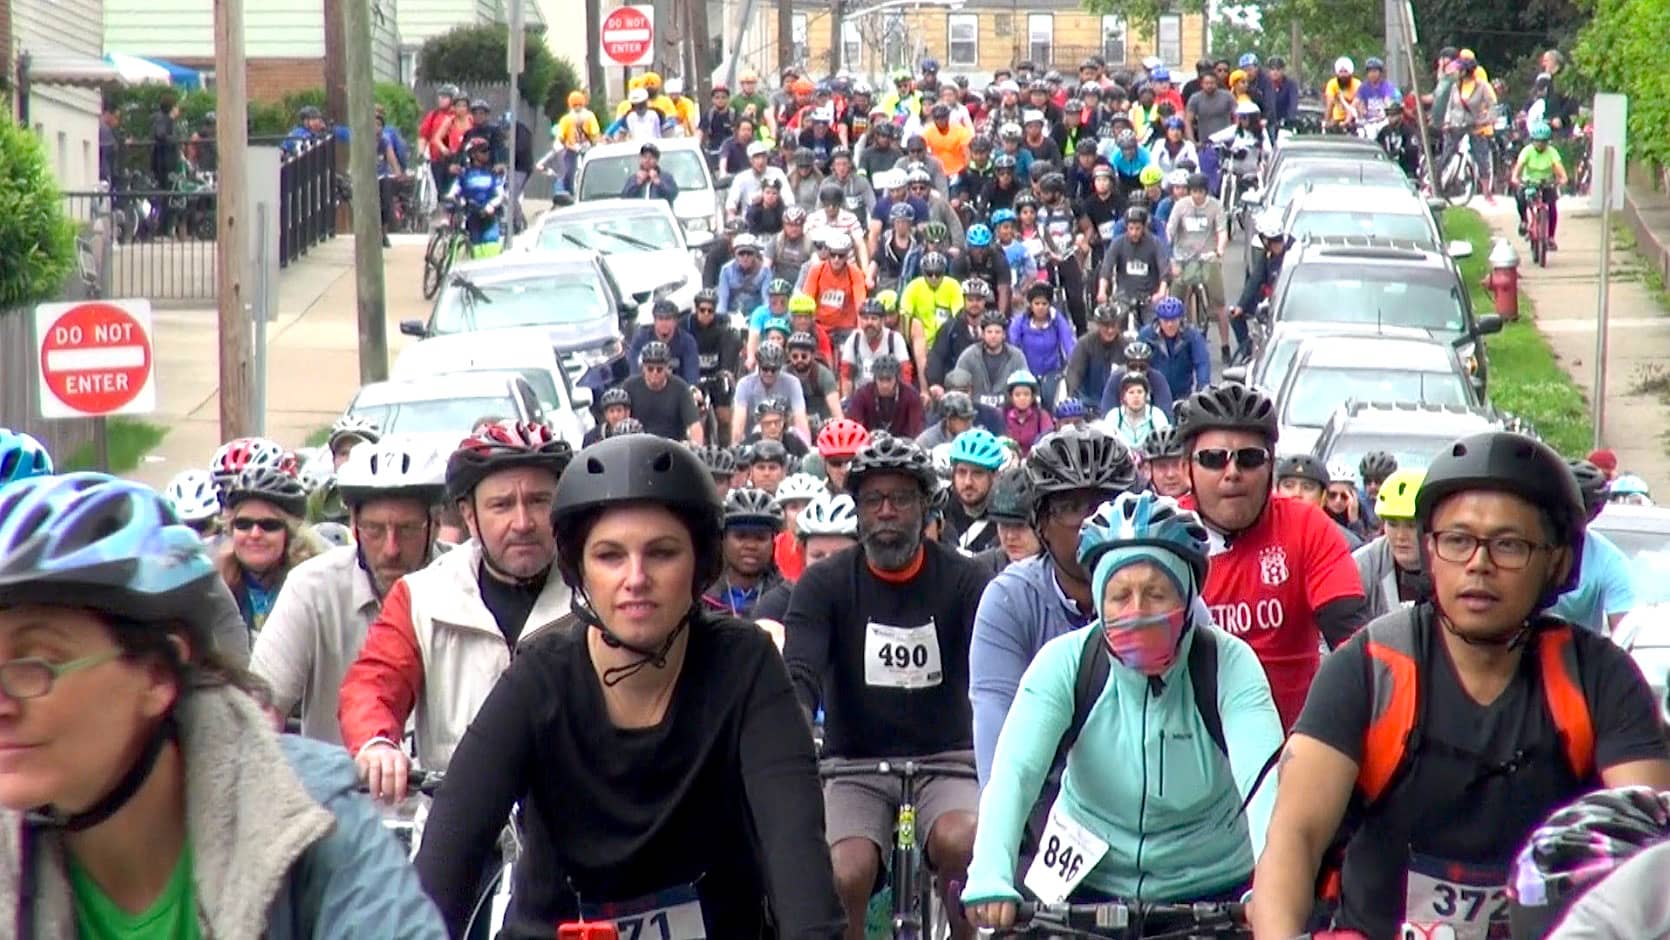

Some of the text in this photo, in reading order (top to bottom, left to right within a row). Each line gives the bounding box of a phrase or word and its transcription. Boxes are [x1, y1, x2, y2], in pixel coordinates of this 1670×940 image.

[608, 17, 645, 29] DO NOT
[611, 43, 641, 54] ENTER
[56, 322, 133, 345] DO NOT
[66, 373, 129, 395] ENTER
[1257, 598, 1283, 629] CO
[878, 642, 928, 668] 490
[1044, 834, 1083, 883] 846
[1433, 883, 1509, 922] 372
